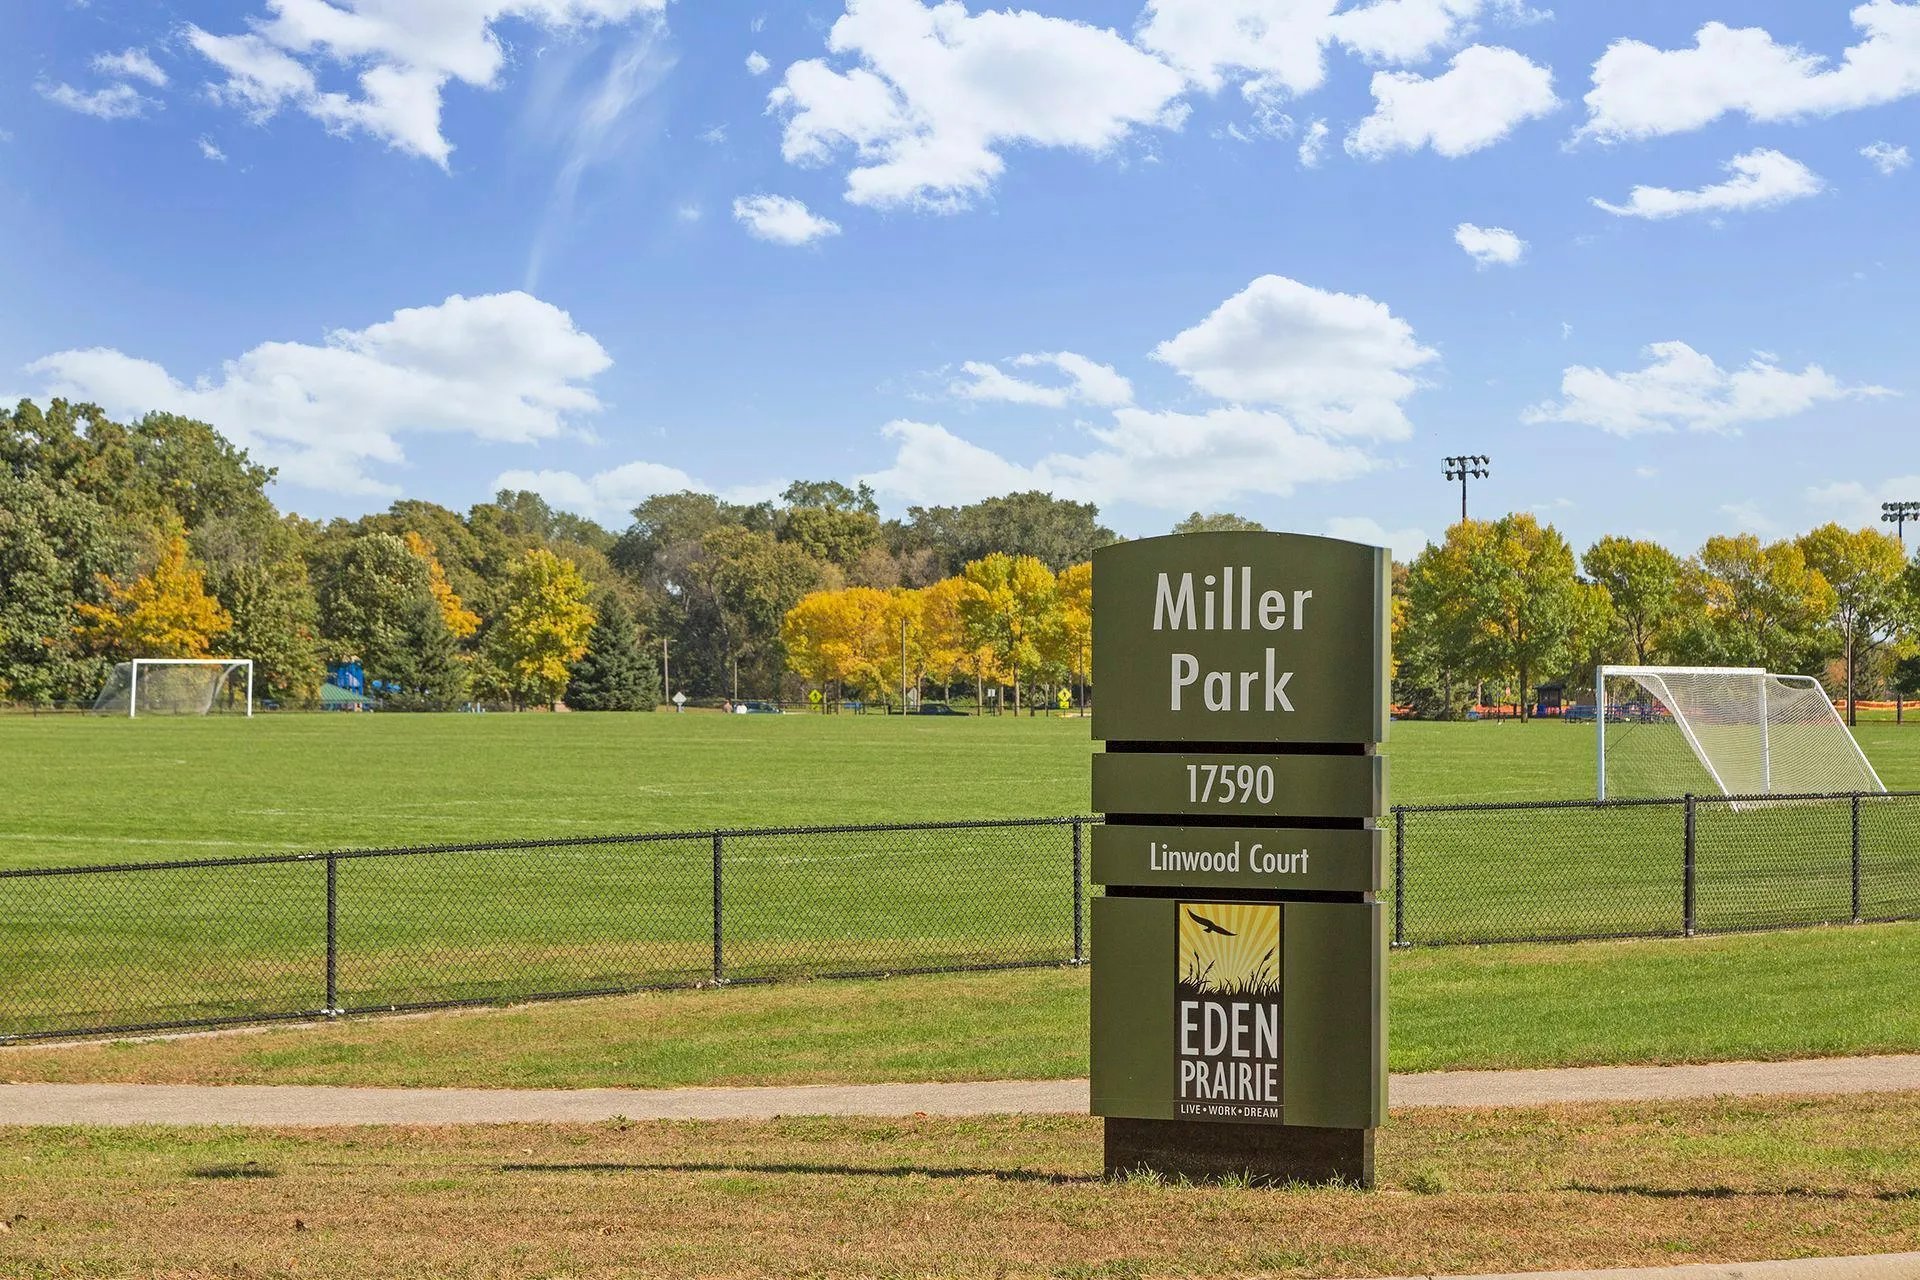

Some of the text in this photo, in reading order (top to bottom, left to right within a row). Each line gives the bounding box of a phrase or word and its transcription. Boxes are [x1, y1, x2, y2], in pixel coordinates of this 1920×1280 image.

[1153, 566, 1313, 631] Miller
[1170, 647, 1295, 712] Park
[1186, 764, 1275, 804] 17590
[1150, 841, 1309, 874] Linwood Court
[1181, 1000, 1278, 1059] EDEN
[1181, 1060, 1278, 1102] PRAIRIE
